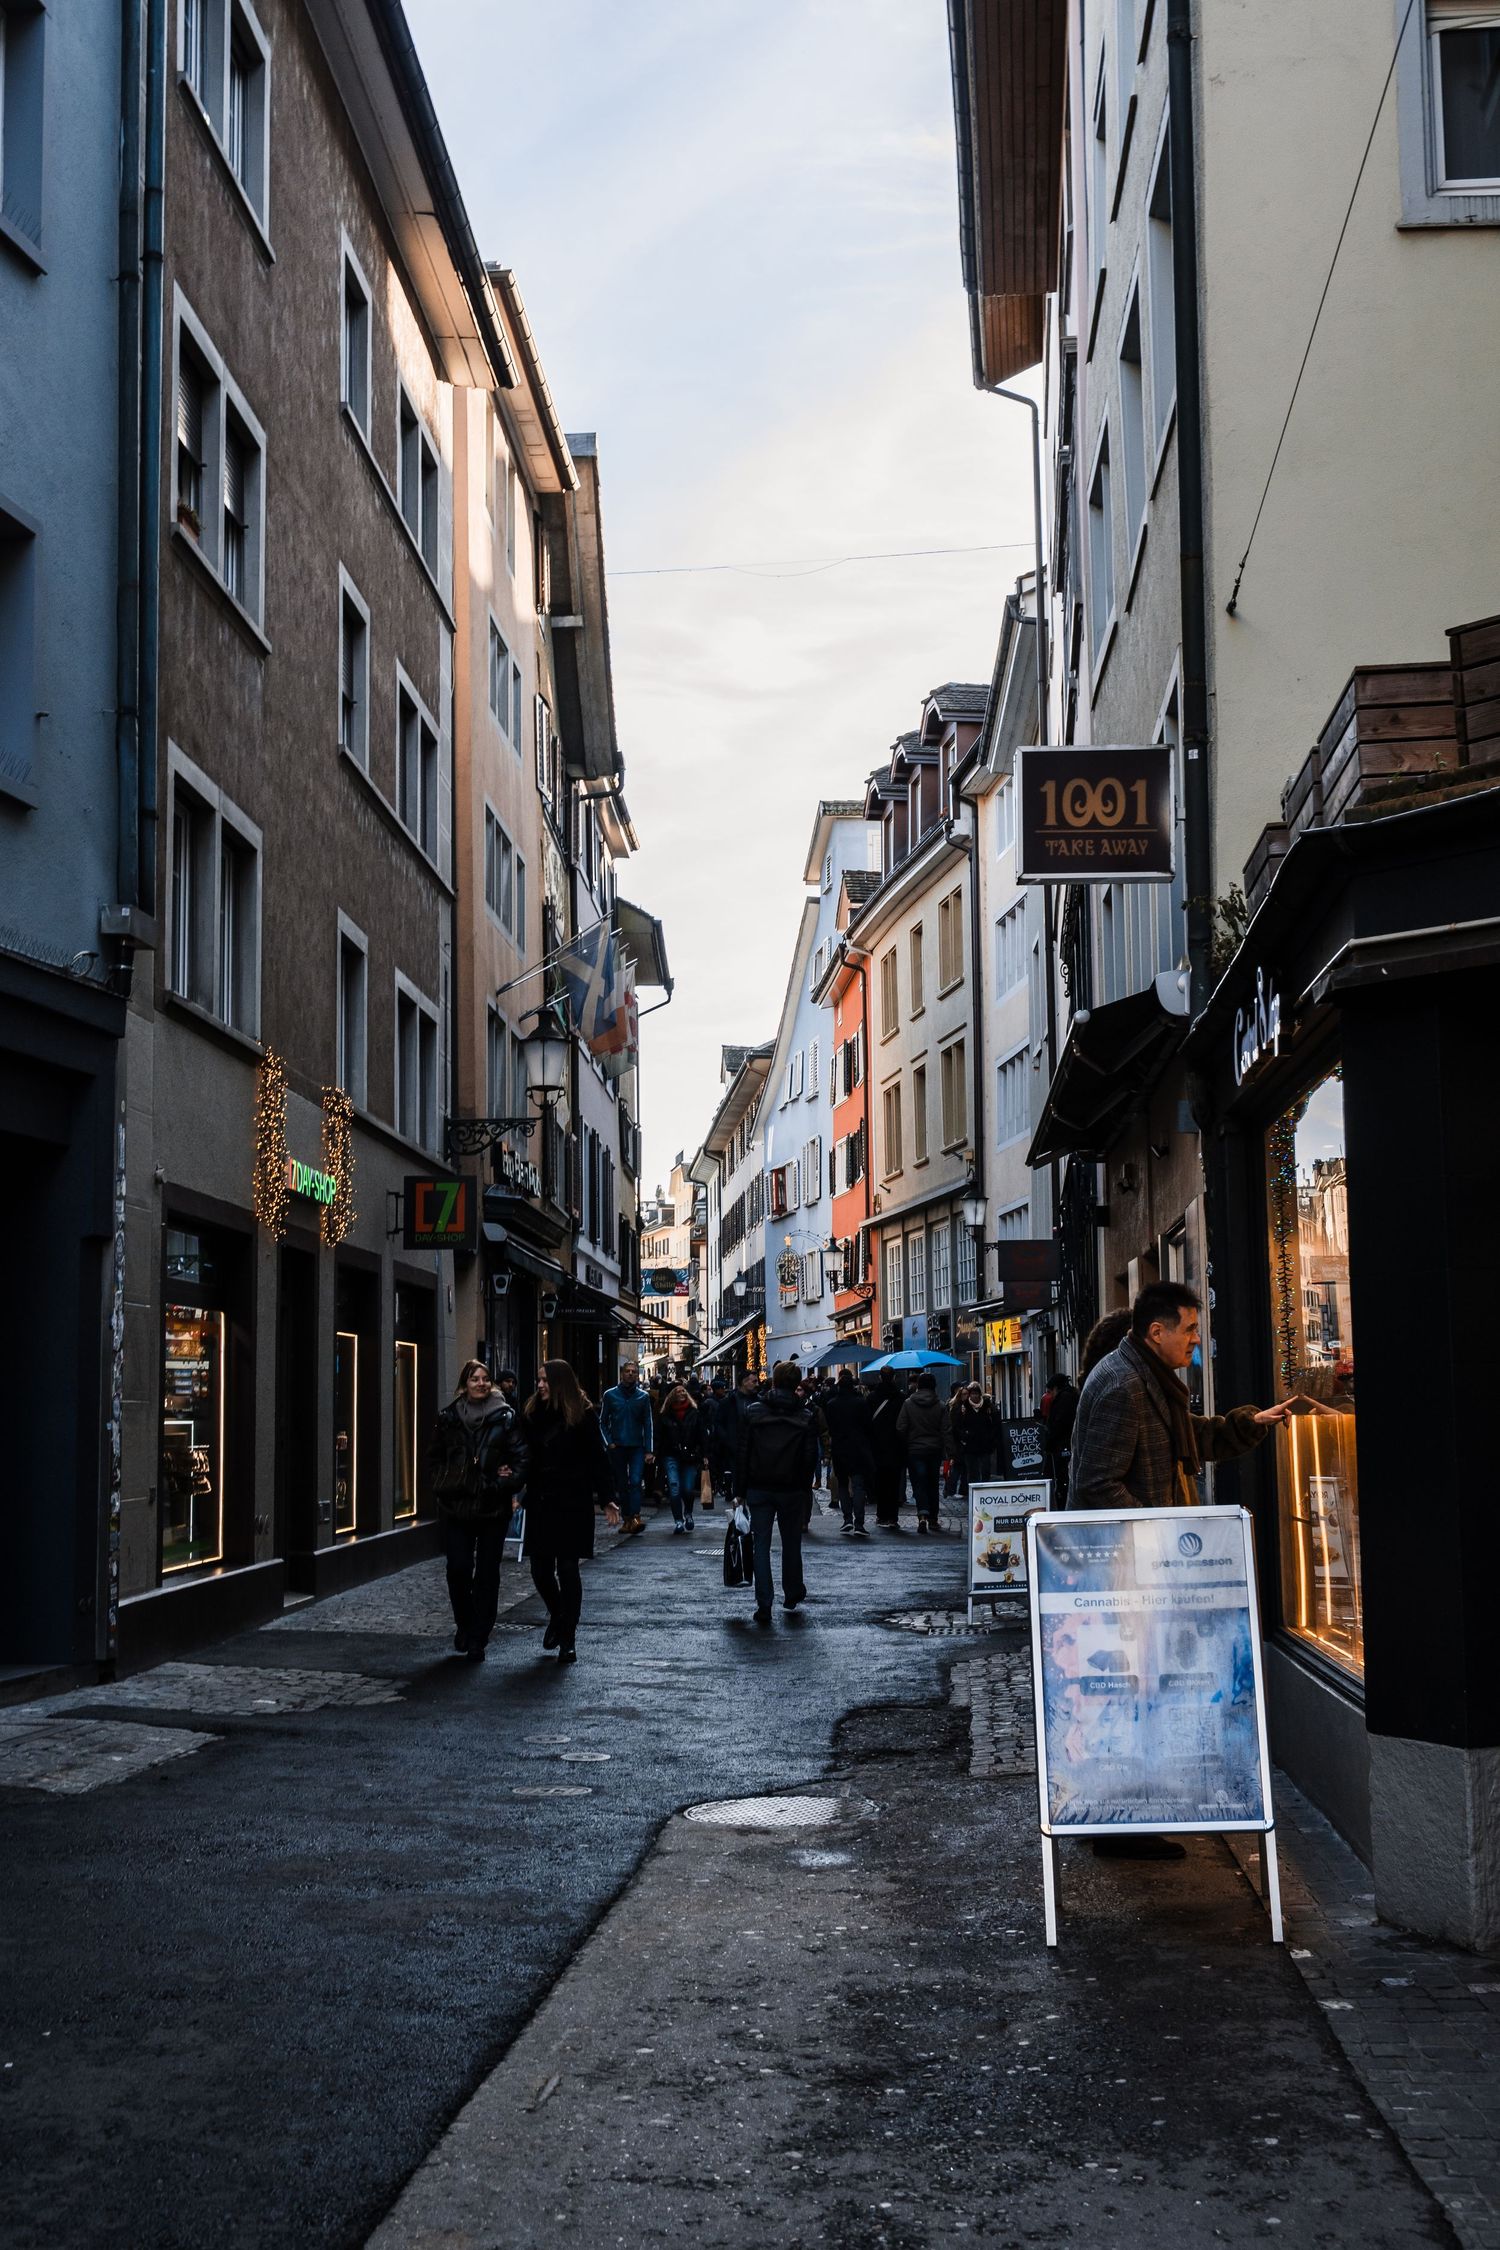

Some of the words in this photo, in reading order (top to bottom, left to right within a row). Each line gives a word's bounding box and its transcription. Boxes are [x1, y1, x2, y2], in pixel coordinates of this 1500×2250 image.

[1039, 777, 1149, 828] 1001
[1045, 839, 1095, 856] TAKE
[1100, 838, 1149, 856] AWAY
[415, 1233, 465, 1242] DAY-SHOP
[1009, 1427, 1040, 1437] BLACK
[1012, 1435, 1039, 1444] WEEK
[1011, 1443, 1042, 1453] BLACK
[979, 1496, 1008, 1505] ROYAL
[1011, 1493, 1041, 1503] DÖNER
[1151, 1559, 1184, 1569] green
[1186, 1557, 1233, 1569] passion
[1074, 1596, 1130, 1608] Cannabis
[1142, 1595, 1167, 1606] Hier
[1171, 1593, 1215, 1605] kaufen!
